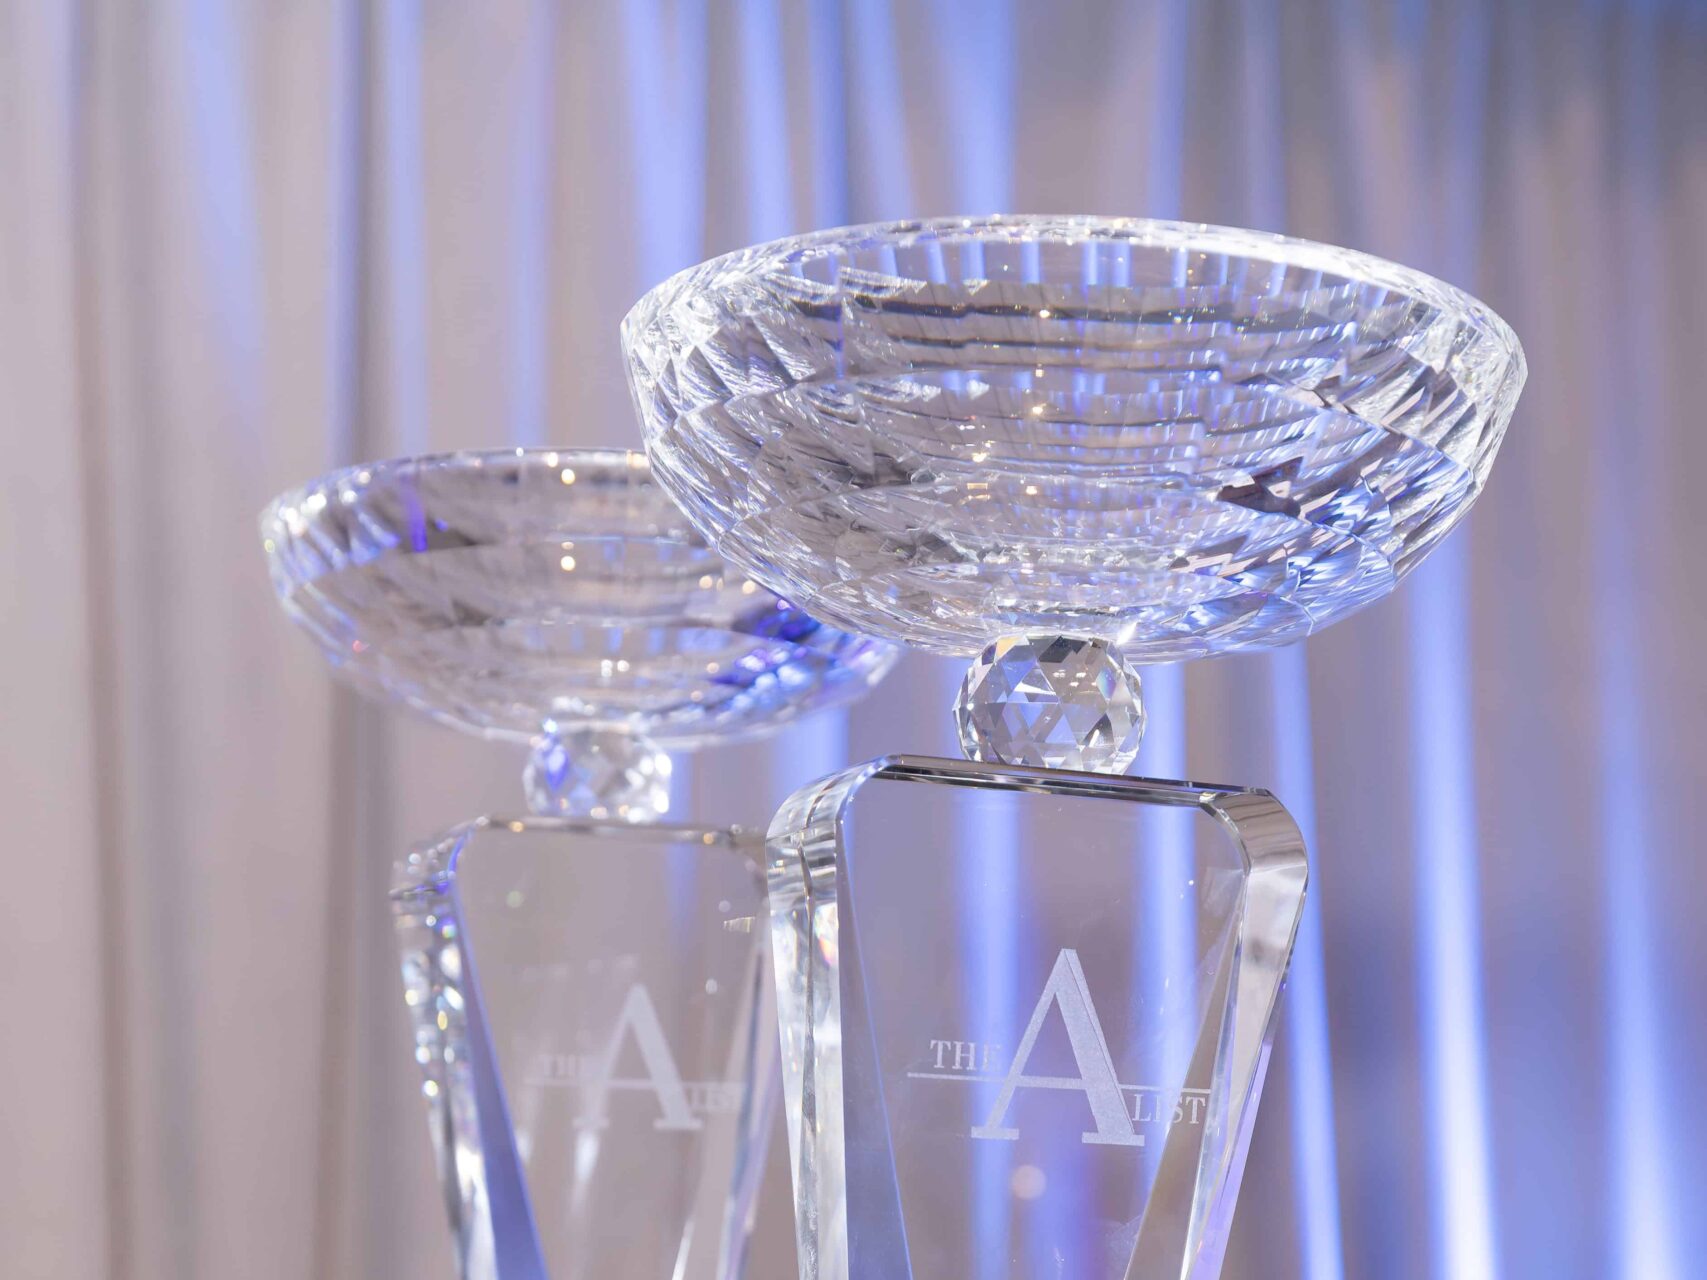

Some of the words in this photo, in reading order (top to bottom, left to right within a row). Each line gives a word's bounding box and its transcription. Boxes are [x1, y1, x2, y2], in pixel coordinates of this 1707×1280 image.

[572, 982, 704, 1131] A
[928, 1038, 1003, 1073] THE
[970, 947, 1145, 1147] A
[1131, 1093, 1207, 1125] LIST
